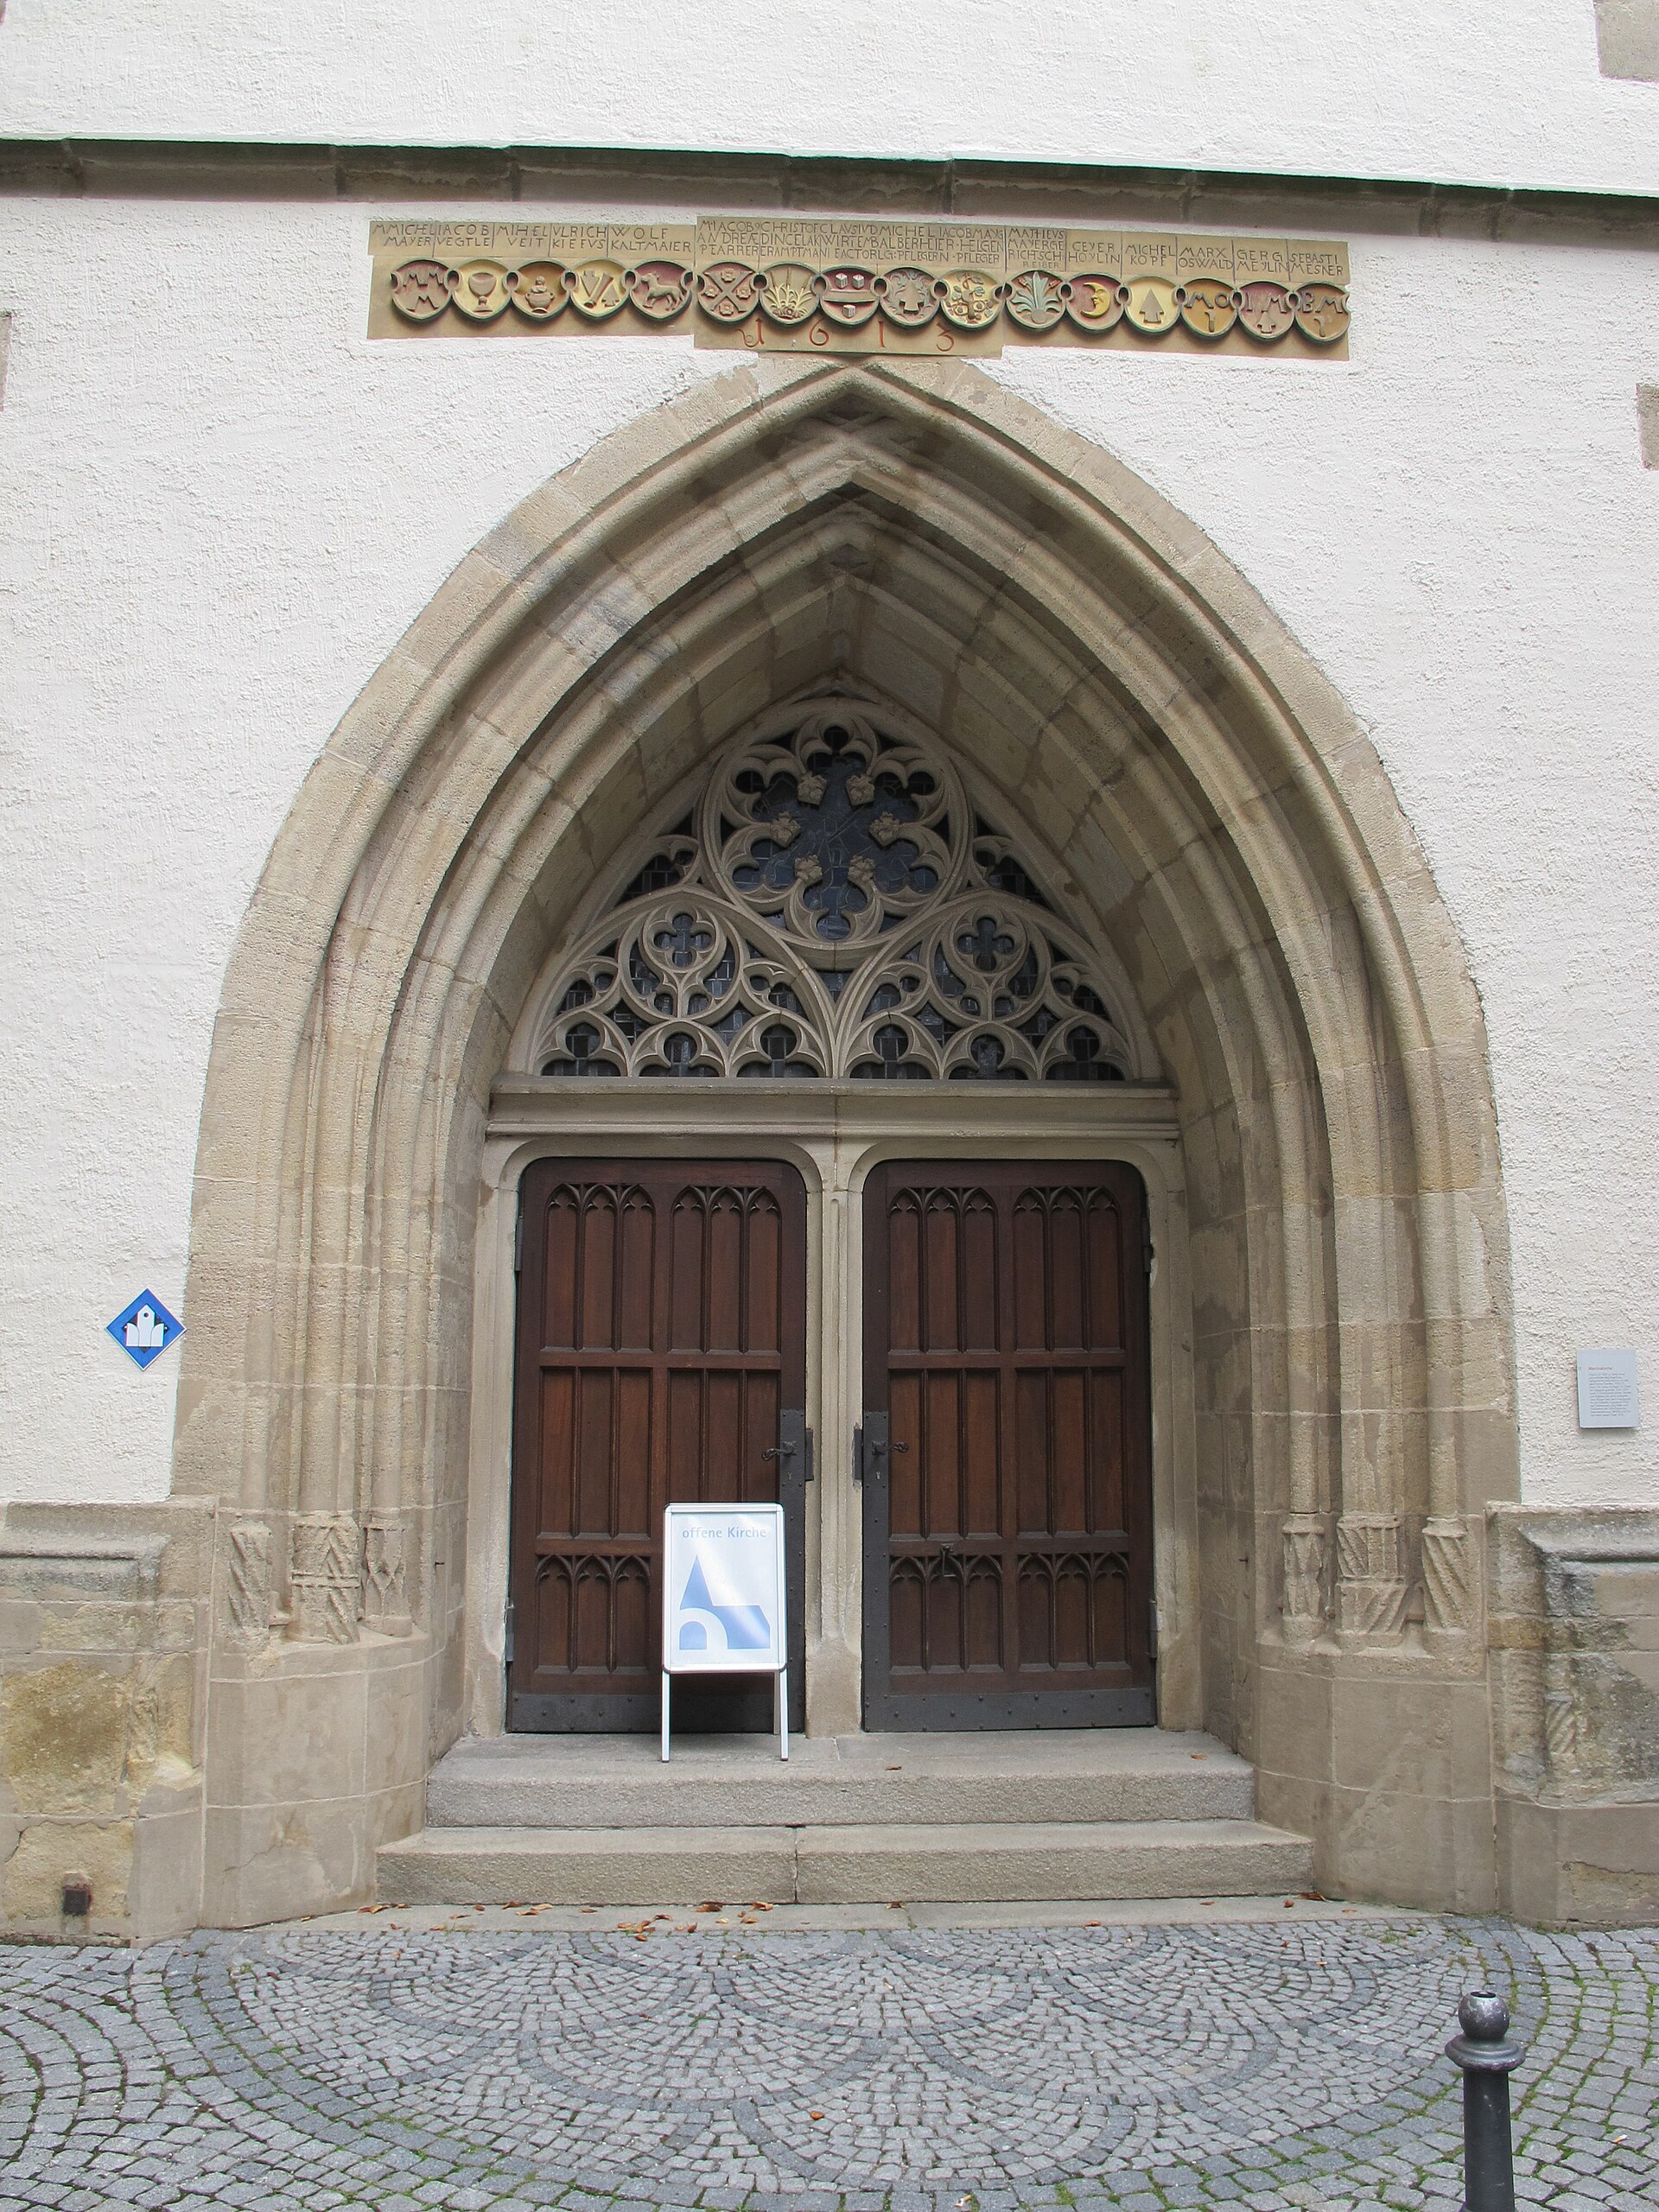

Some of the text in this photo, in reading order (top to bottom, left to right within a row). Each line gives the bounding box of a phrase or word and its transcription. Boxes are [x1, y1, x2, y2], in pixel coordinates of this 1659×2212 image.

[438, 224, 490, 236] IACOB
[611, 226, 668, 239] WOLF
[880, 225, 935, 238] MICHEL
[384, 236, 431, 246] MAYER
[508, 238, 543, 248] VEIT
[611, 239, 692, 252] KALTMAIER
[1125, 244, 1175, 257] MICHEL
[1179, 247, 1228, 258] MARX
[1130, 256, 1166, 266] KOPF
[1178, 257, 1233, 270] OSWALD
[683, 1526, 766, 1538] offene Kirche
